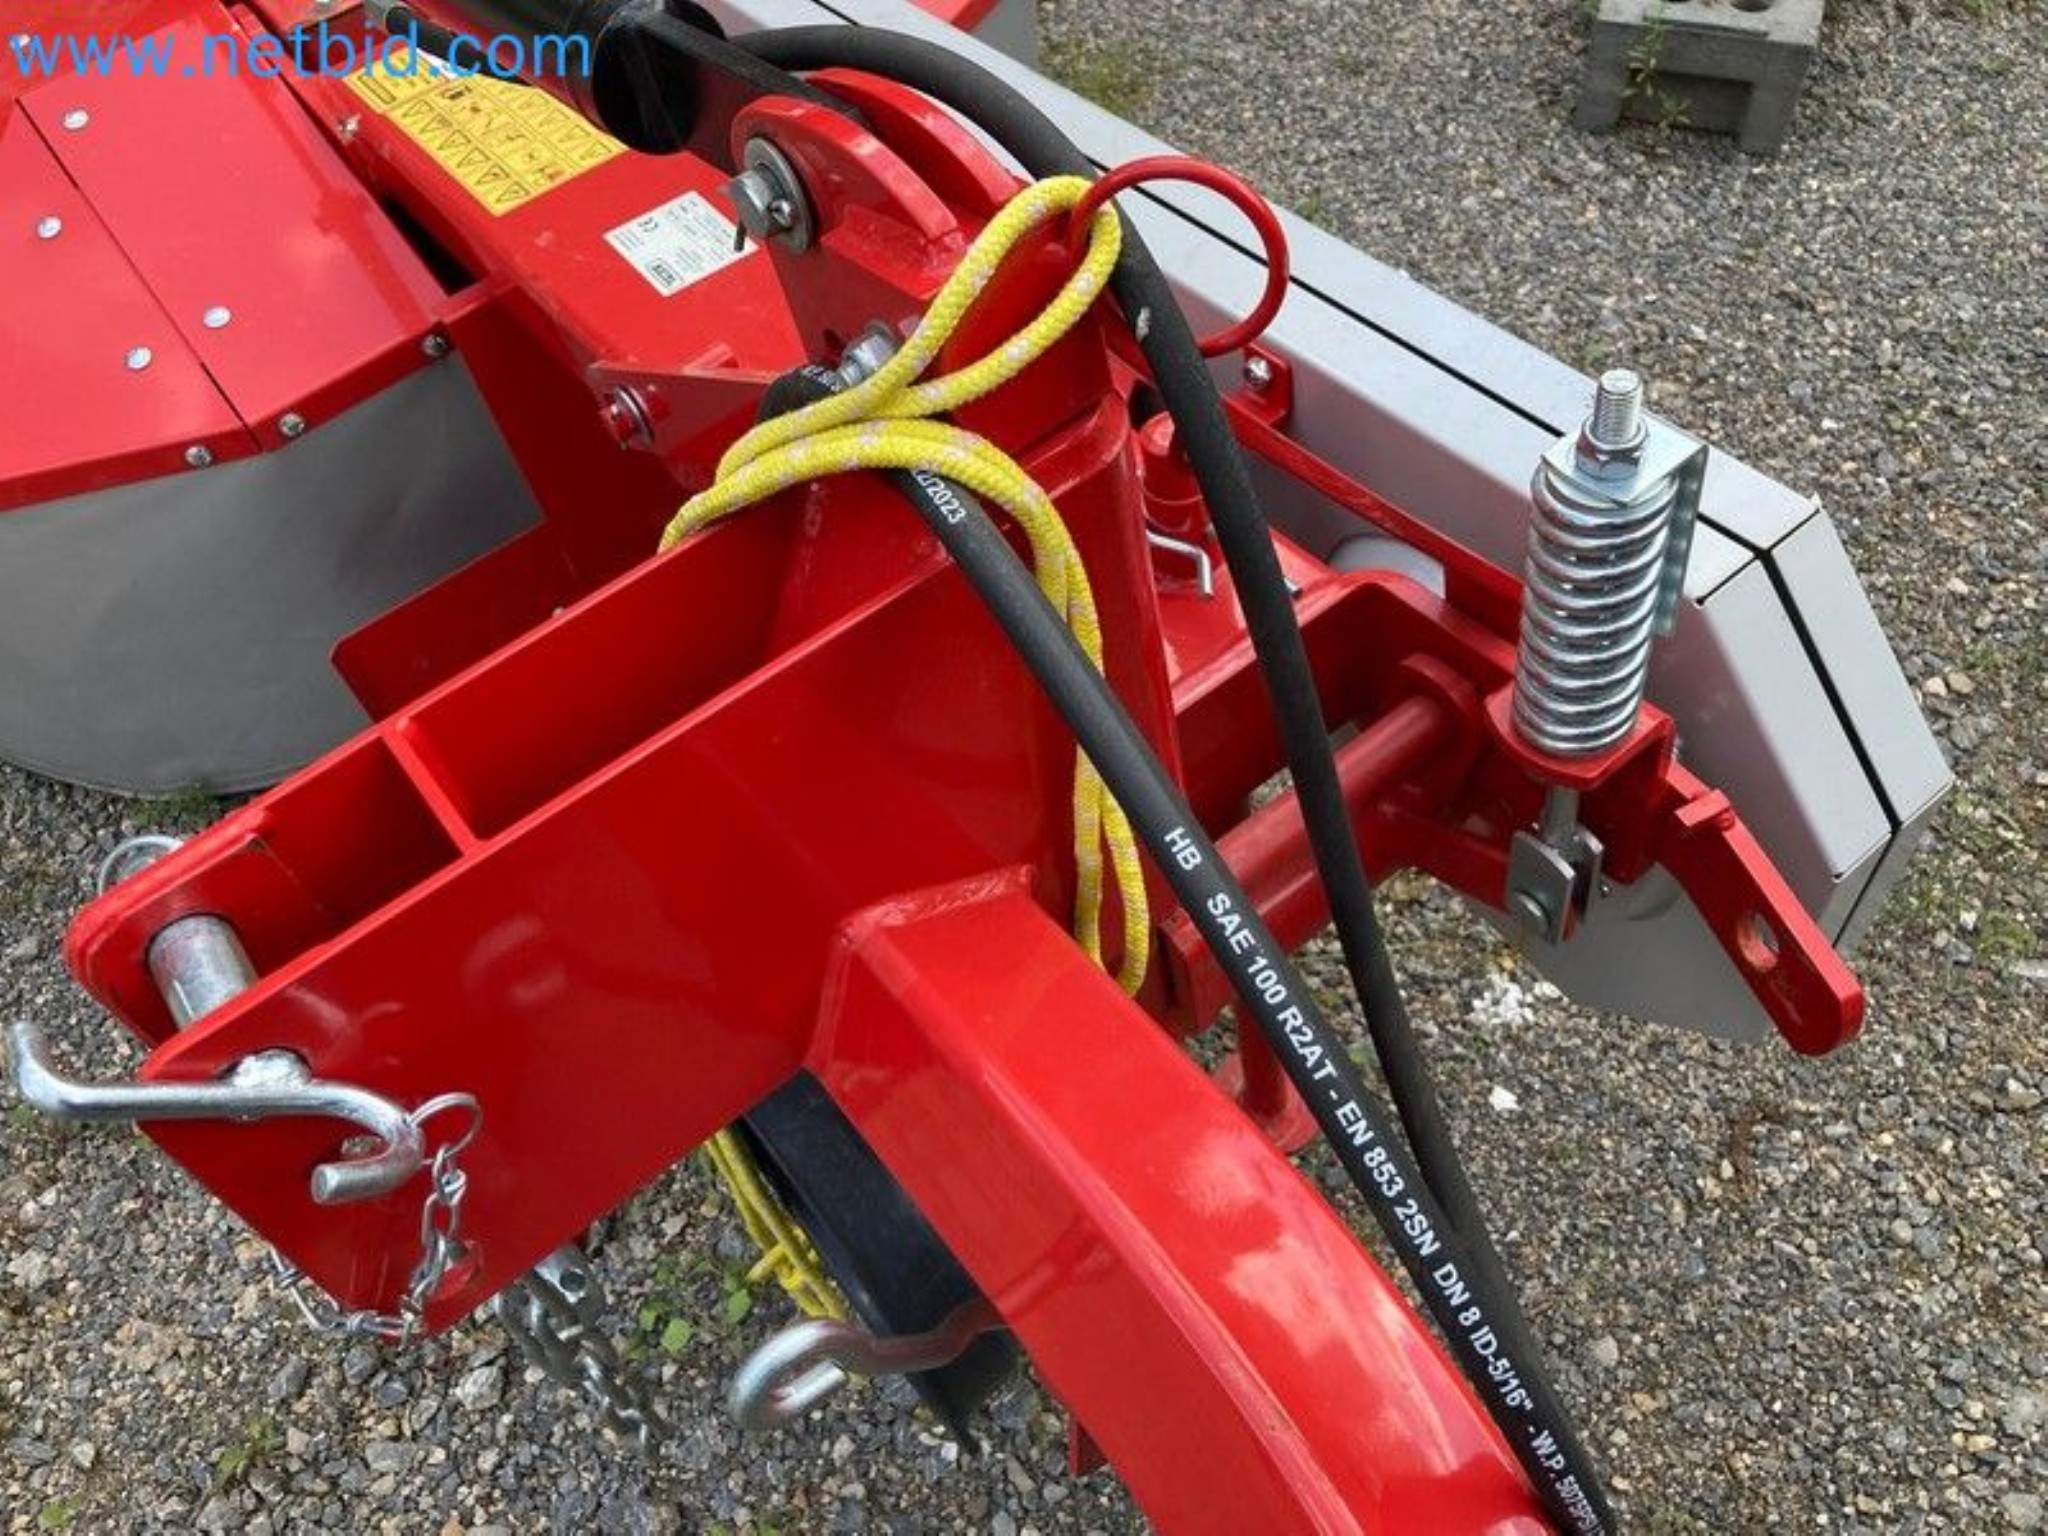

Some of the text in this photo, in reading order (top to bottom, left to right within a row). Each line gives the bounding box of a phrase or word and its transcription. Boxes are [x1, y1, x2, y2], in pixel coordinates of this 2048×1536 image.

[911, 468, 966, 524] 2/2023
[1164, 826, 1203, 870] HB
[1207, 892, 1256, 954] SAE
[1248, 956, 1287, 1004] 100
[1276, 1006, 1338, 1080] R2AT
[1335, 1100, 1374, 1146] EN
[1363, 1146, 1404, 1198] 853
[1394, 1199, 1441, 1257] 2SN
[1433, 1263, 1470, 1306] DN
[1458, 1306, 1481, 1327] 8
